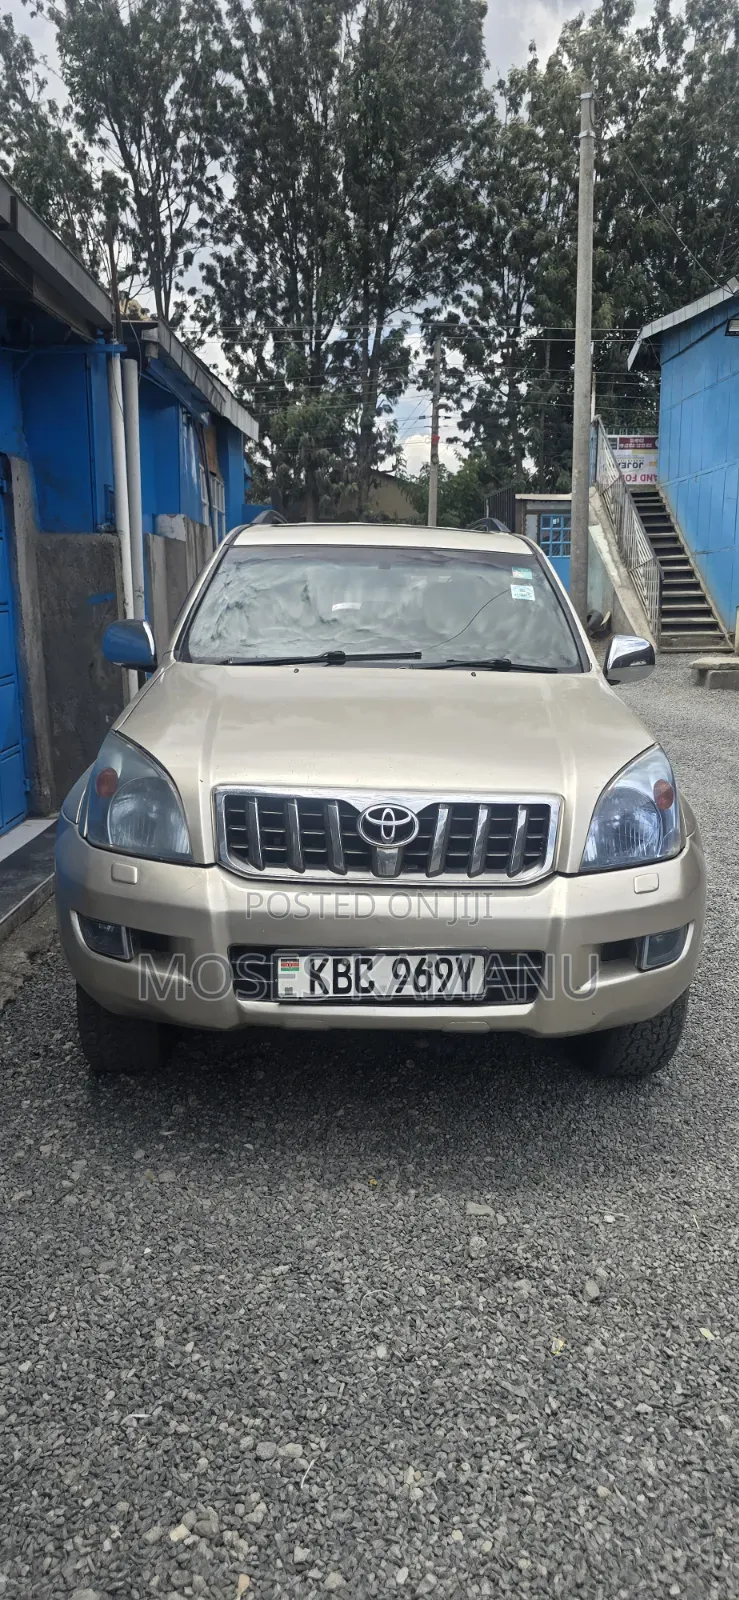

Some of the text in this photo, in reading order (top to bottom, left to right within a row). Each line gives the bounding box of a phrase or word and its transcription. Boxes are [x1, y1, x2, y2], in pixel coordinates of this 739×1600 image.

[621, 474, 637, 482] FO
[309, 956, 476, 995] KBC 969Y
